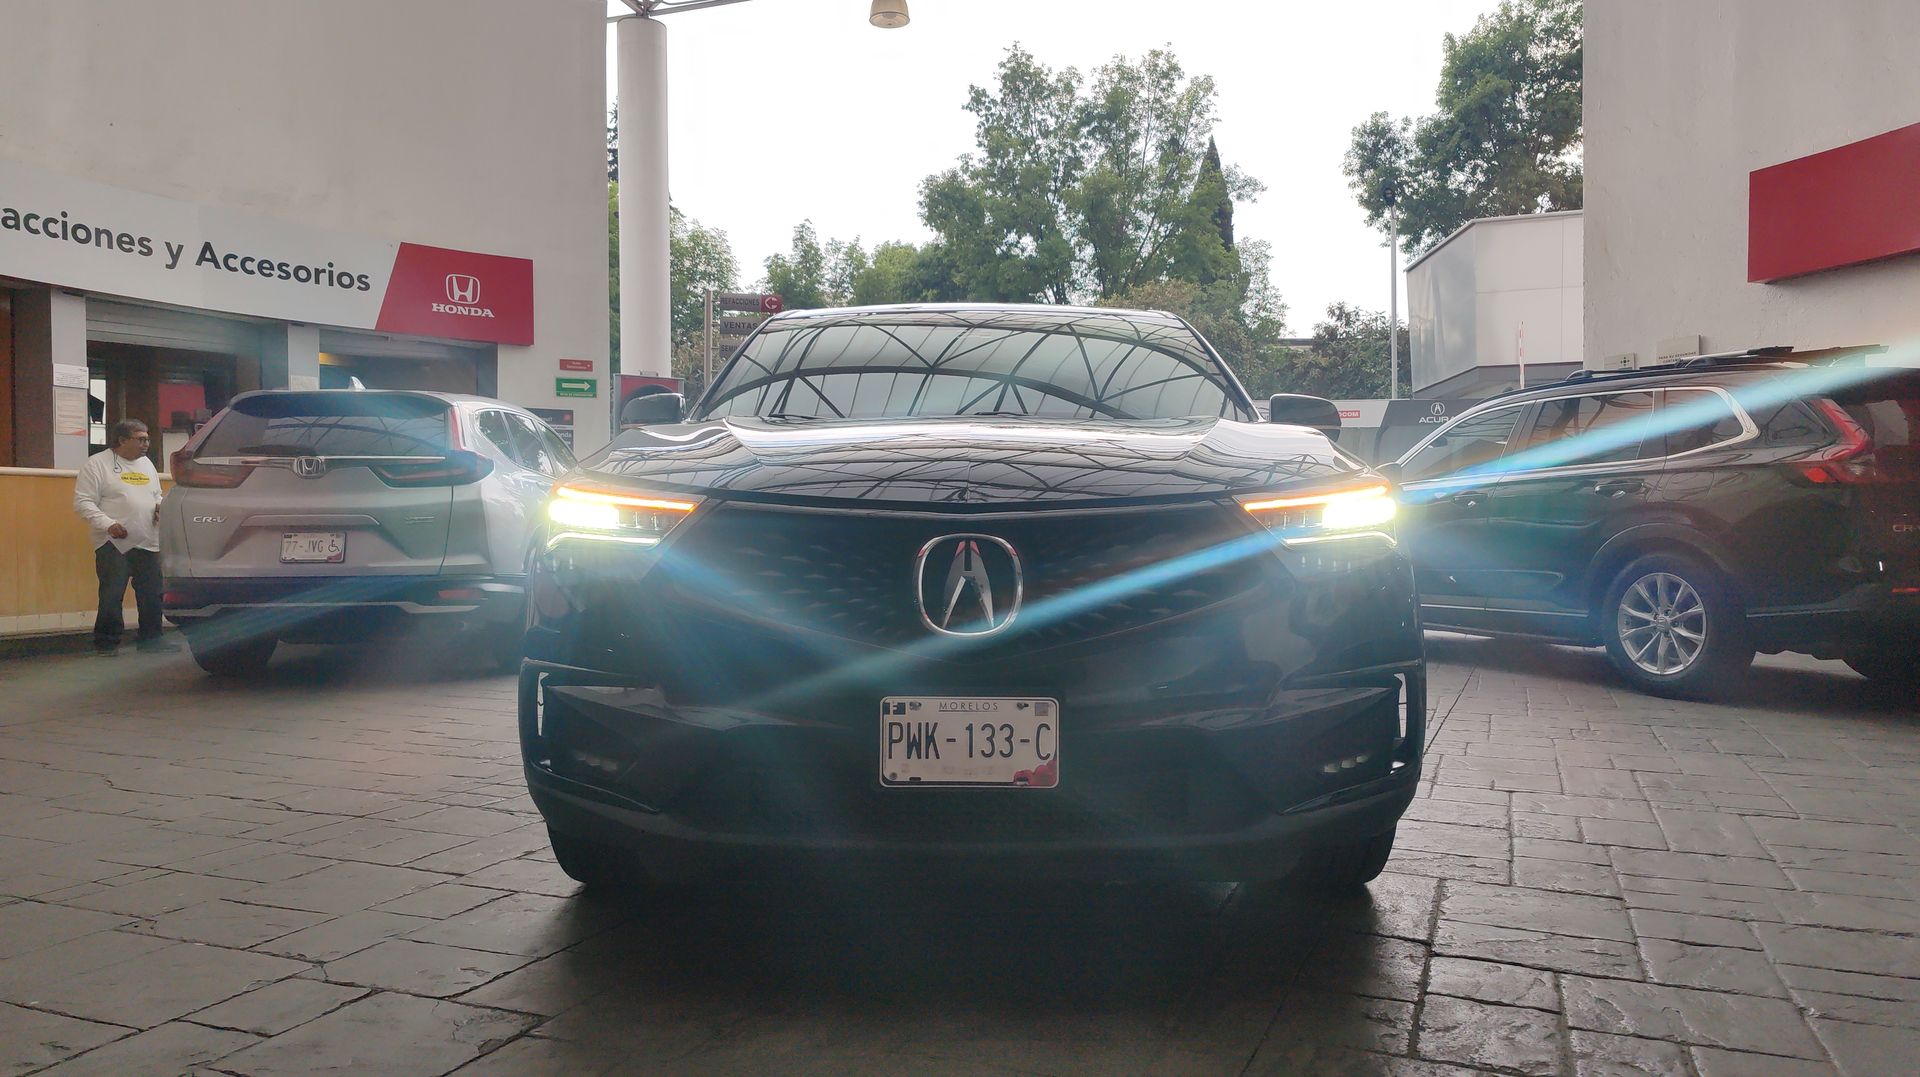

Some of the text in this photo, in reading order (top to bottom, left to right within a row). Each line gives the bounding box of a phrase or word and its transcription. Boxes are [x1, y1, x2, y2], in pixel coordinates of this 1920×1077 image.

[1, 207, 371, 292] acciones y Accesorios
[720, 297, 760, 306] REFACCIONES
[431, 303, 495, 318] HONDA
[724, 321, 758, 330] VENTAS
[193, 515, 225, 523] CR-V
[1892, 524, 1920, 532] CR-
[938, 701, 999, 711] MORELOS
[888, 722, 1051, 760] PWK-133-C
